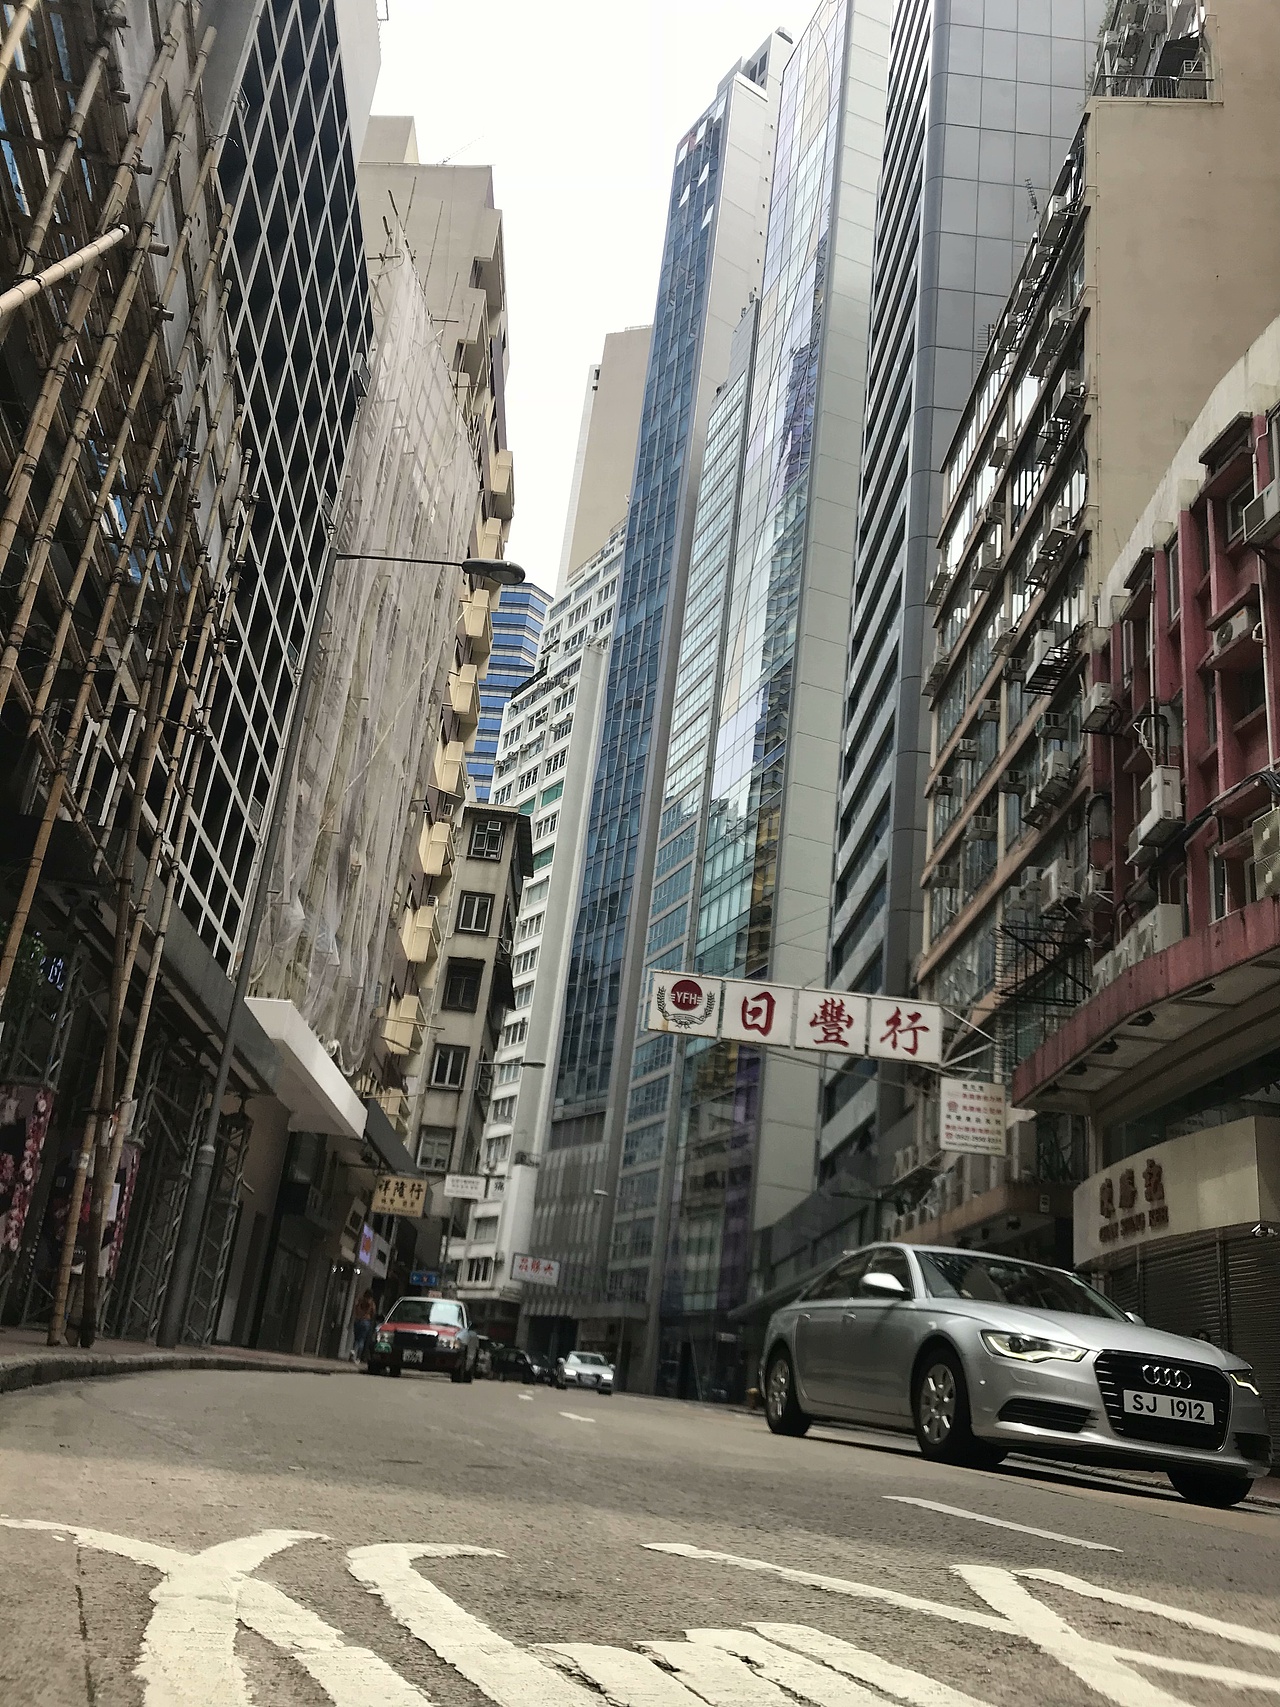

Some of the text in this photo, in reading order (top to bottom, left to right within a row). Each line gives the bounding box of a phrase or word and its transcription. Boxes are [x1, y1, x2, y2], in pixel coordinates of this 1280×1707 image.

[676, 991, 698, 1005] YFH
[1132, 1394, 1205, 1420] SJ 1912
